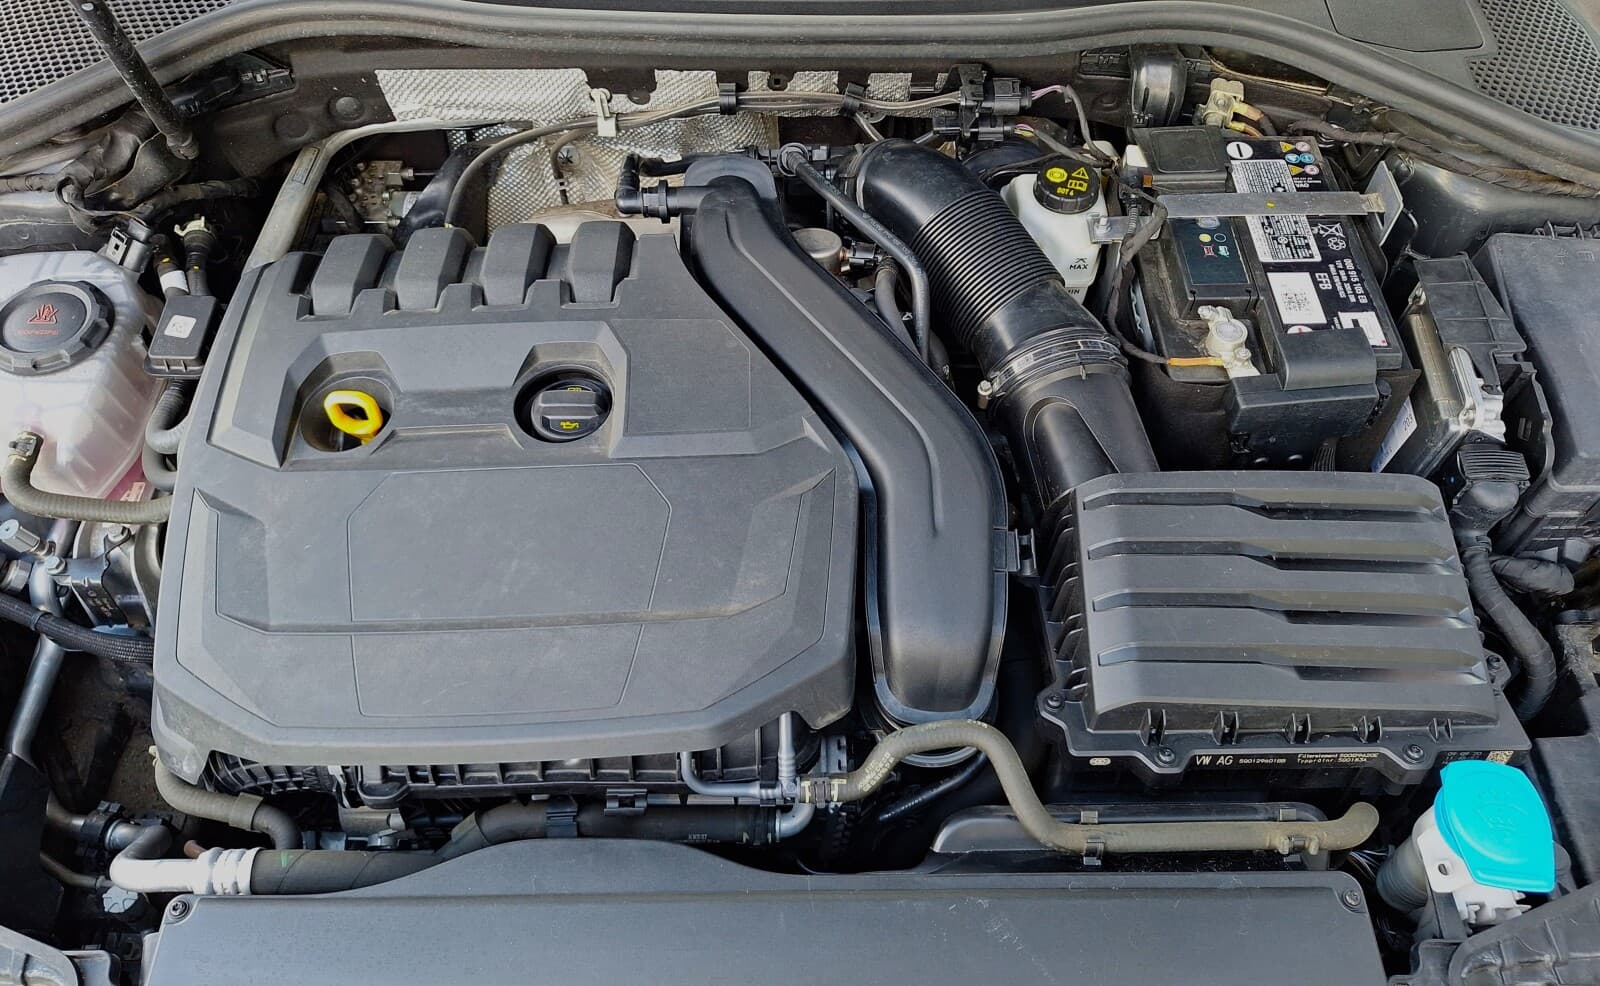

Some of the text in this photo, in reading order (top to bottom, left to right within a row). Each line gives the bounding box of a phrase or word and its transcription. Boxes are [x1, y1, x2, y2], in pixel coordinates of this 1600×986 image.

[1057, 187, 1069, 195] DOT
[1343, 258, 1355, 270] 000
[1314, 272, 1332, 290] EFB
[1348, 270, 1360, 282] 915
[1353, 283, 1364, 294] 105
[1195, 755, 1212, 766] VW
[1216, 755, 1233, 766] AG
